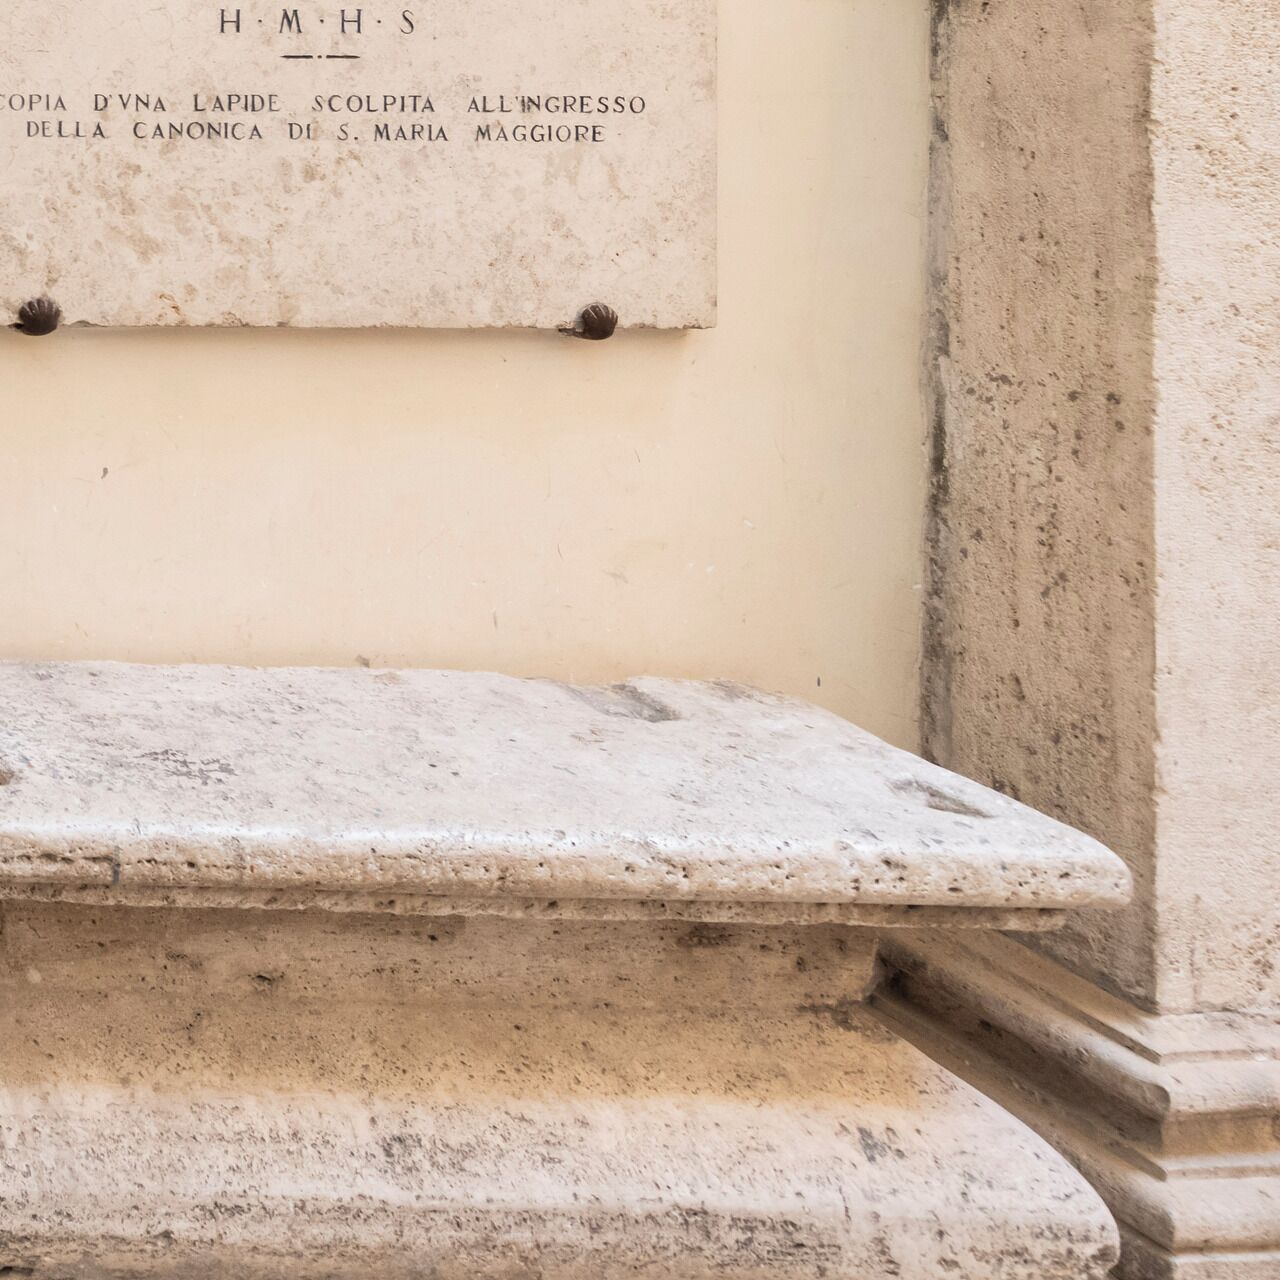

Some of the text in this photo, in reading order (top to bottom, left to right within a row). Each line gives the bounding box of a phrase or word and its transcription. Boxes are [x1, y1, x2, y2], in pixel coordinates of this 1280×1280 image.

[193, 93, 279, 113] LAPIDE
[314, 94, 435, 113] SCOLPITA
[26, 120, 605, 143] DELLA CANONICA DI S. MARIA MAGGIORE
